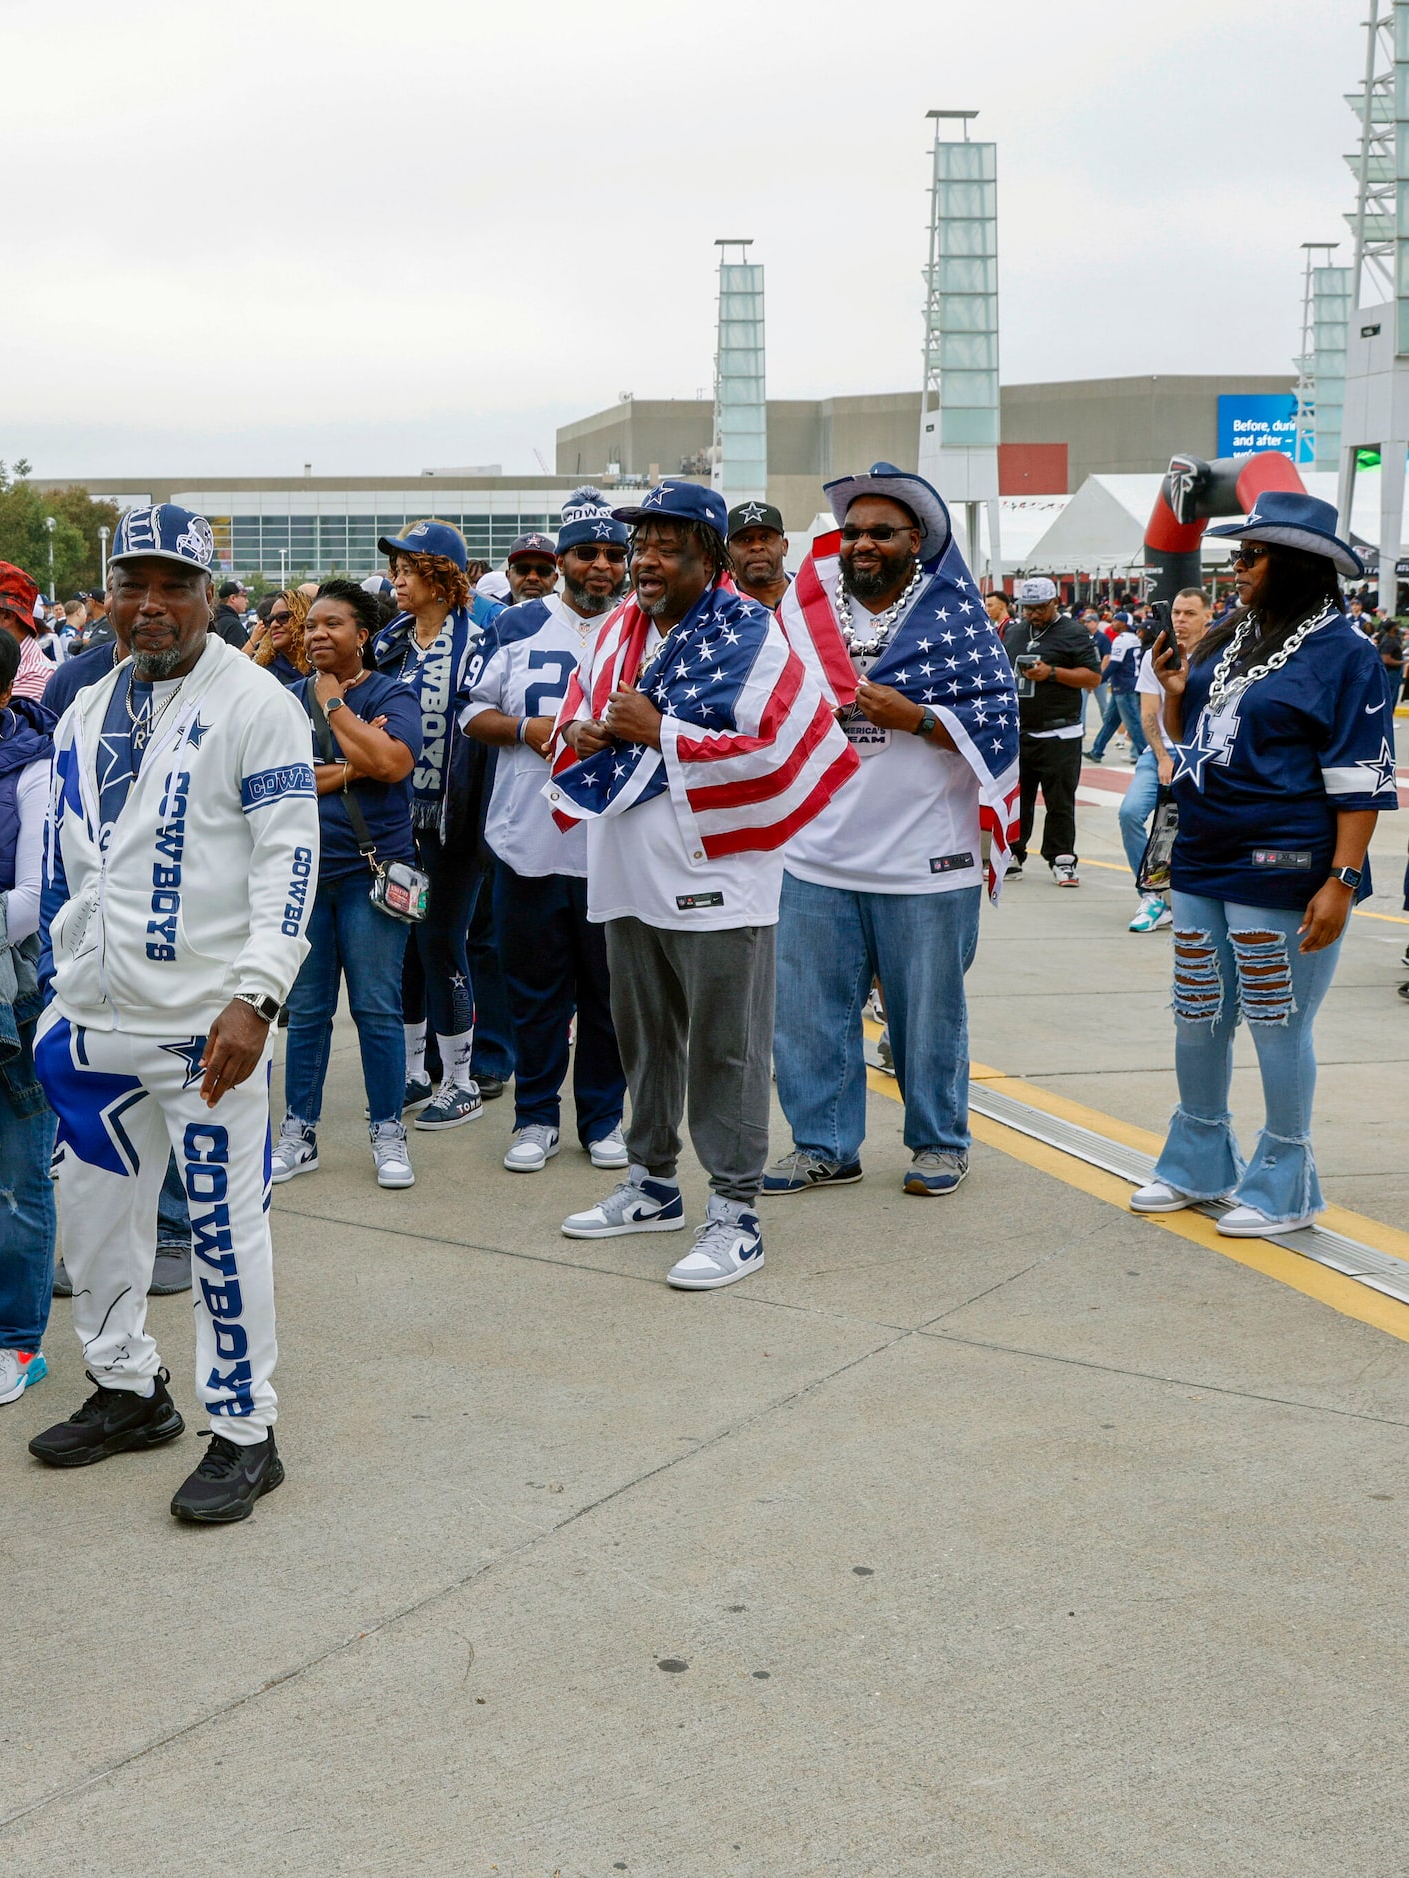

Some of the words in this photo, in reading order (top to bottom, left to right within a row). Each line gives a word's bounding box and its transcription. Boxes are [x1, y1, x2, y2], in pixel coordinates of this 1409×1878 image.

[1233, 419, 1270, 432] Before,
[1233, 435, 1253, 446] and
[1256, 434, 1282, 446] after
[844, 727, 886, 735] MERICA'S
[281, 846, 312, 937] COWBO
